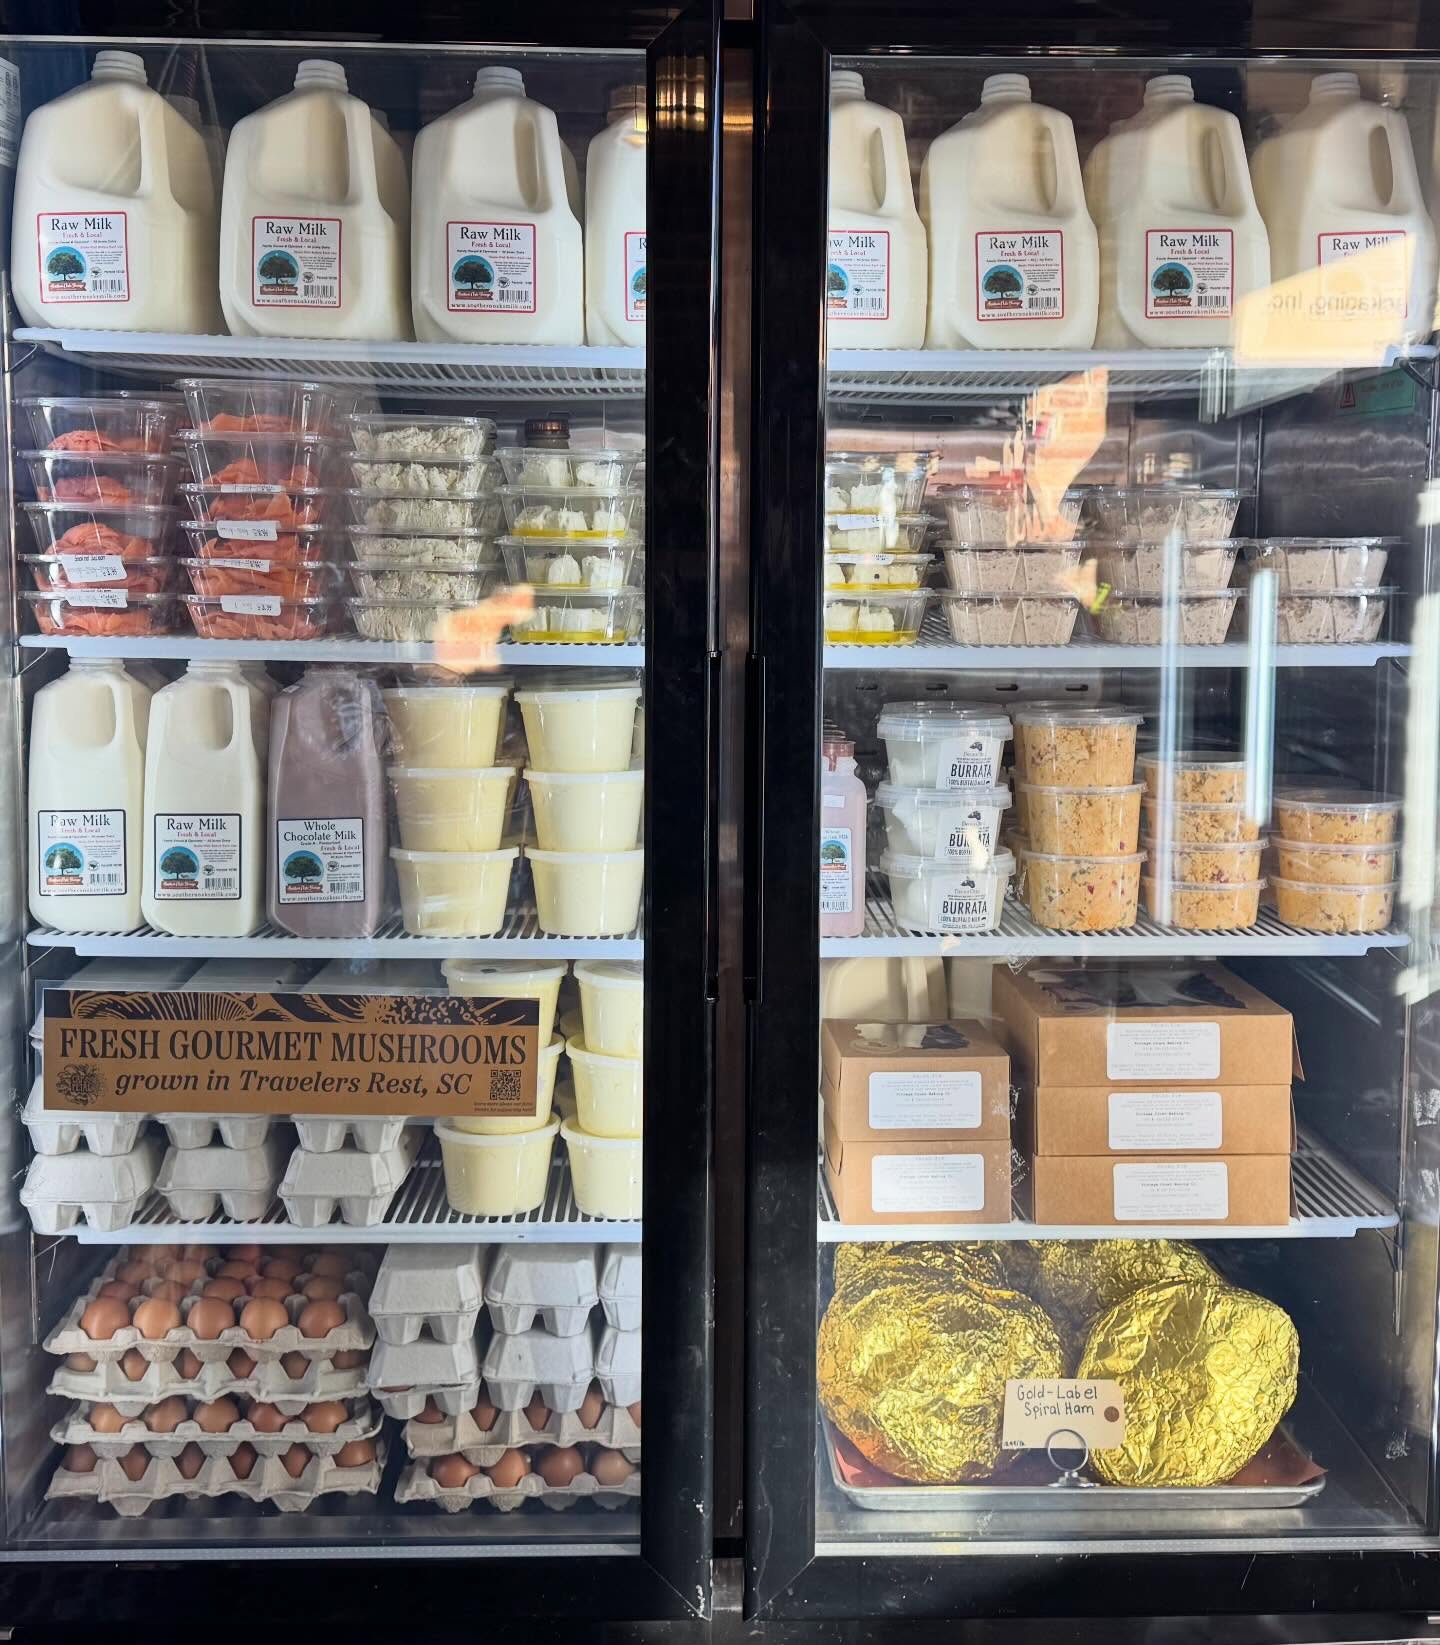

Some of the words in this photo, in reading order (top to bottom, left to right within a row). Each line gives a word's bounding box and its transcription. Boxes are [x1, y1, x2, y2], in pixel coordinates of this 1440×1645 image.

[51, 218, 79, 230] Raw
[84, 217, 112, 229] Milk
[266, 221, 294, 234] Raw
[298, 222, 327, 235] Milk
[460, 227, 488, 239] Raw
[493, 228, 521, 240] Milk
[848, 236, 876, 248] Milk
[989, 237, 1017, 249] Raw
[1021, 236, 1049, 248] Milk
[1160, 235, 1187, 247] Raw
[1192, 235, 1219, 246] Milk
[1332, 239, 1360, 251] Raw
[950, 764, 992, 778] BURRATA
[82, 814, 111, 826] Milk
[167, 818, 193, 830] Raw
[199, 818, 227, 830] Milk
[304, 821, 336, 831] Whole
[283, 832, 331, 841] Chocolate
[335, 831, 357, 840] Milk
[942, 901, 987, 915] BURRATA
[59, 1028, 160, 1060] FRESH
[169, 1030, 322, 1062] GOURMET
[331, 1032, 526, 1065] MUSHROOMS
[115, 1071, 198, 1095] grown
[207, 1070, 235, 1090] in
[239, 1070, 360, 1093] Travelers
[366, 1072, 428, 1098] Rest,
[436, 1073, 472, 1095] SC
[1017, 1384, 1097, 1401] Gold-Label
[1024, 1402, 1061, 1420] Spiral
[1065, 1402, 1094, 1415] Ham
